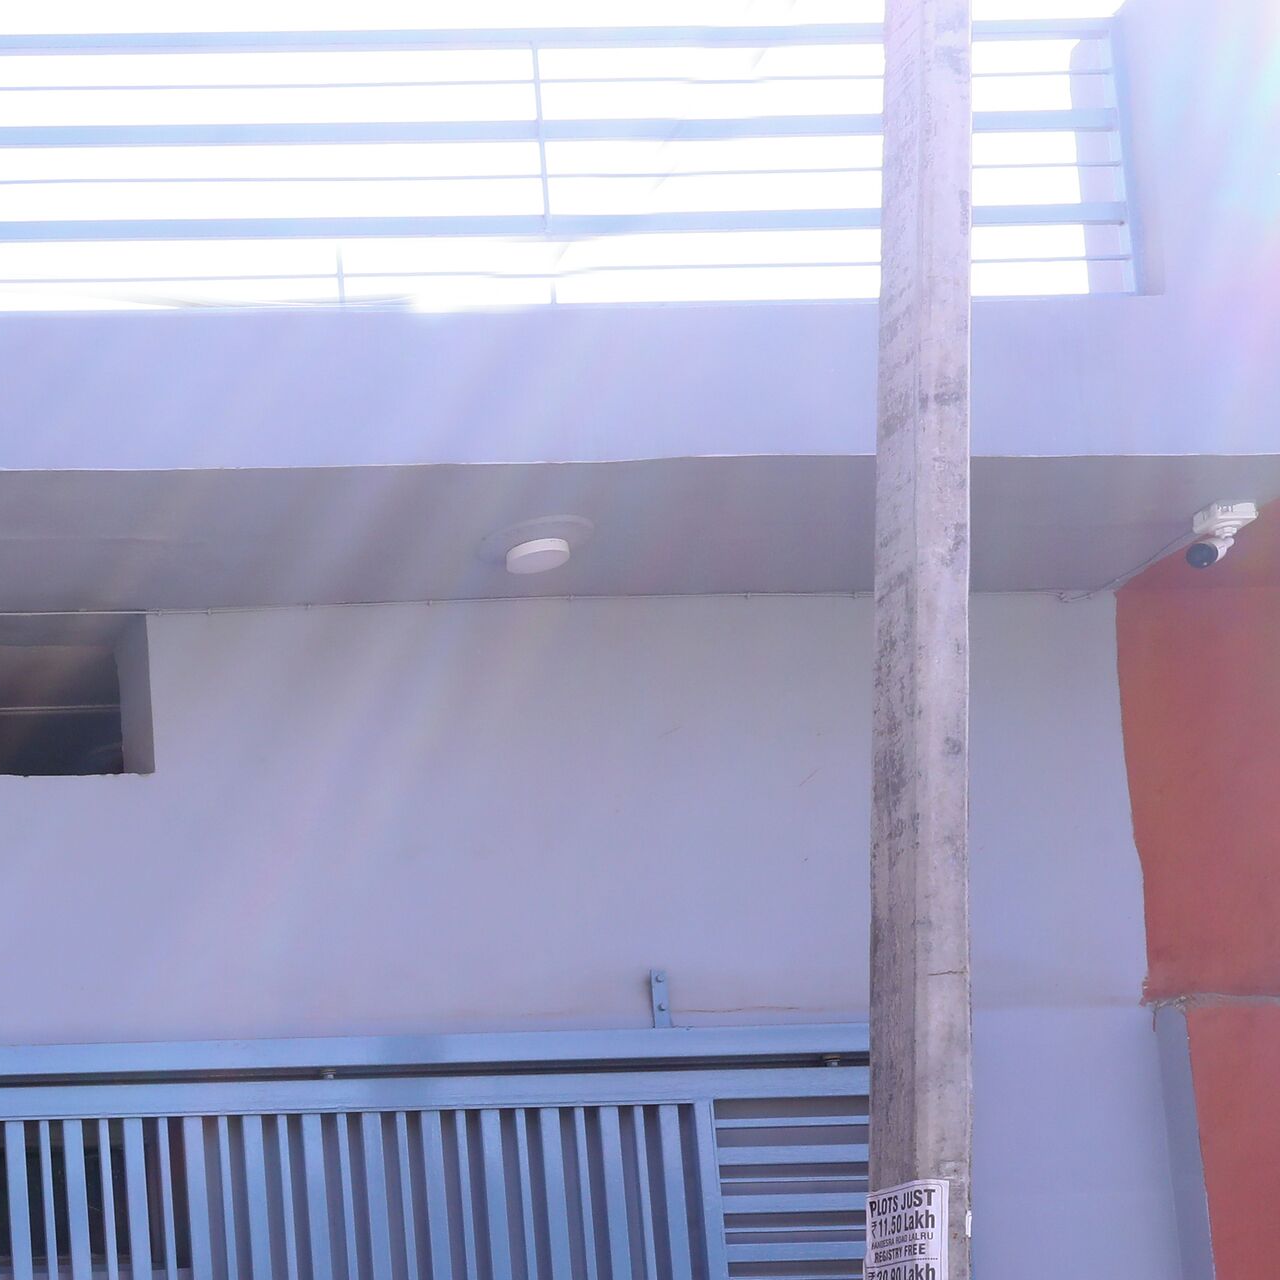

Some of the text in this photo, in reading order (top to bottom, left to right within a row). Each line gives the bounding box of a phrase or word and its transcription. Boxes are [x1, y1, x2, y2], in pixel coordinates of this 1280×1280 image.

[869, 1189, 936, 1218] PLOTS JUST
[904, 1210, 935, 1231] Lakh
[908, 1232, 933, 1242] LALRU
[874, 1243, 926, 1263] REGISTRY FREE
